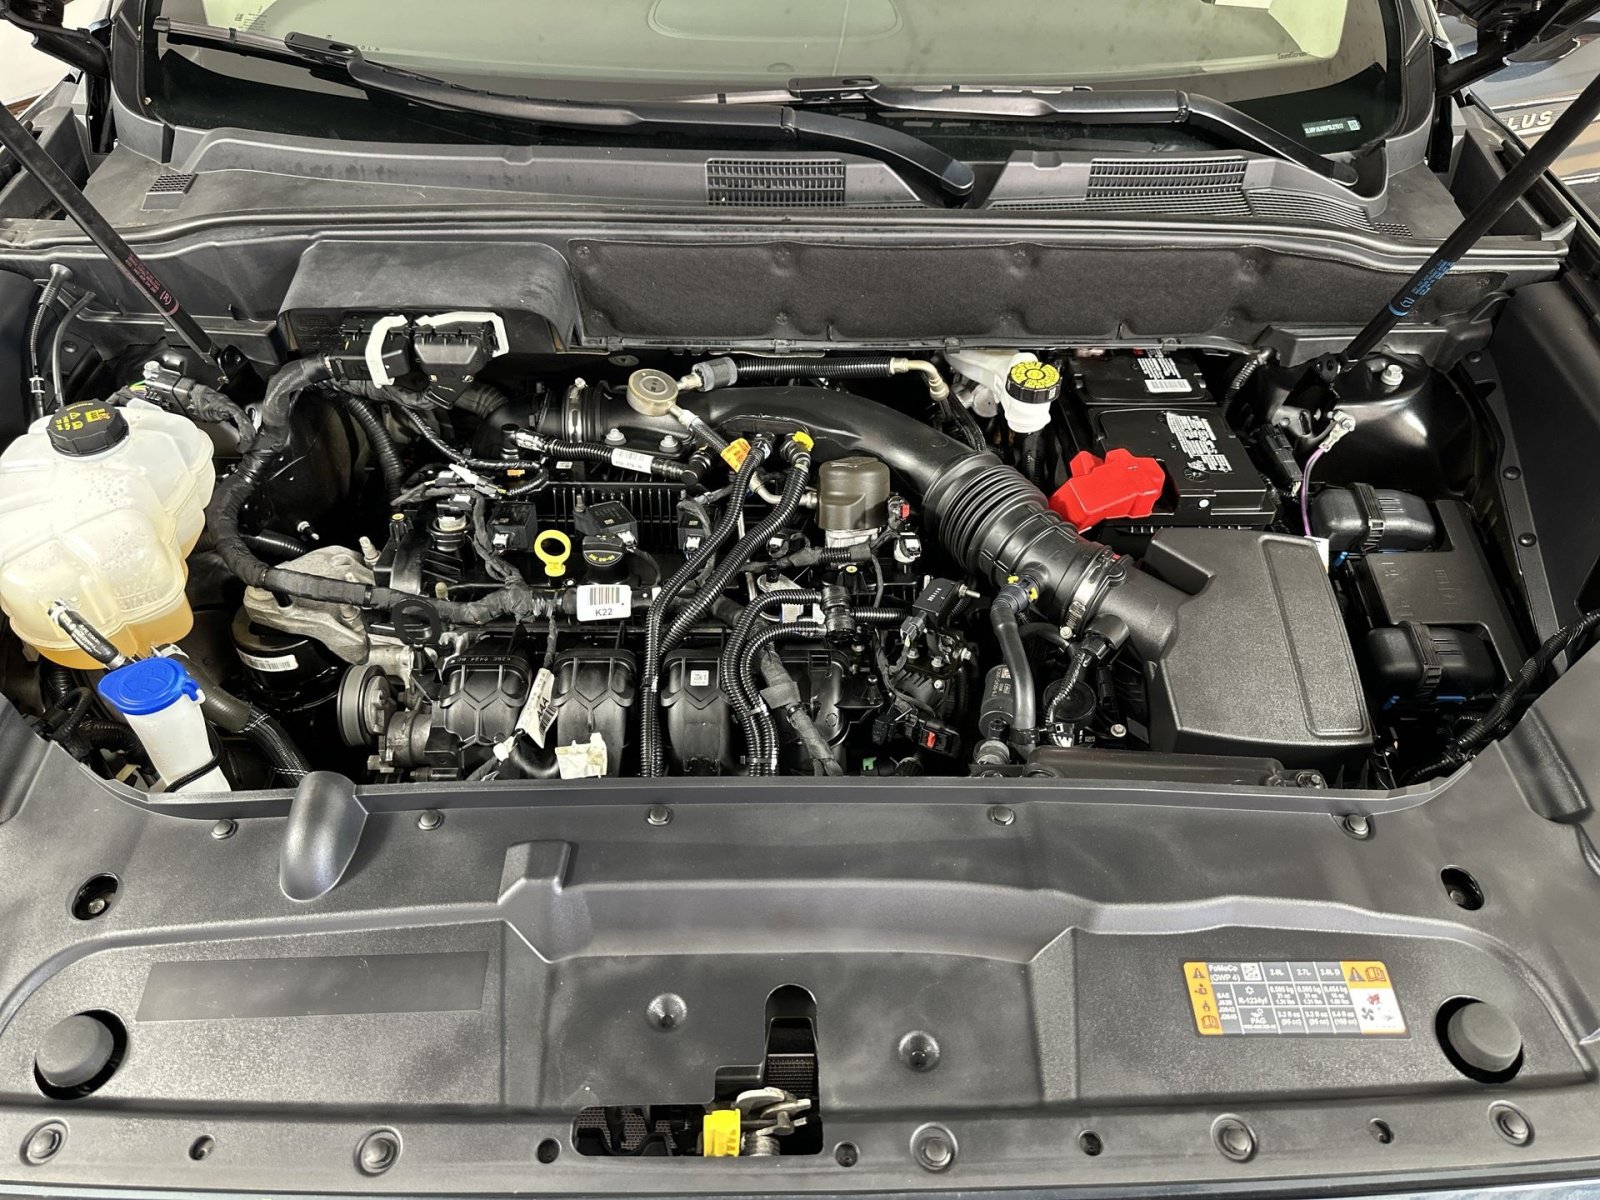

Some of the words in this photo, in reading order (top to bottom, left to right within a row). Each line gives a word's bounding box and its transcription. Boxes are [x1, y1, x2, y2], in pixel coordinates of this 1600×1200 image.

[1502, 110, 1553, 130] LUS
[595, 608, 613, 617] K22
[536, 697, 549, 720] AAA
